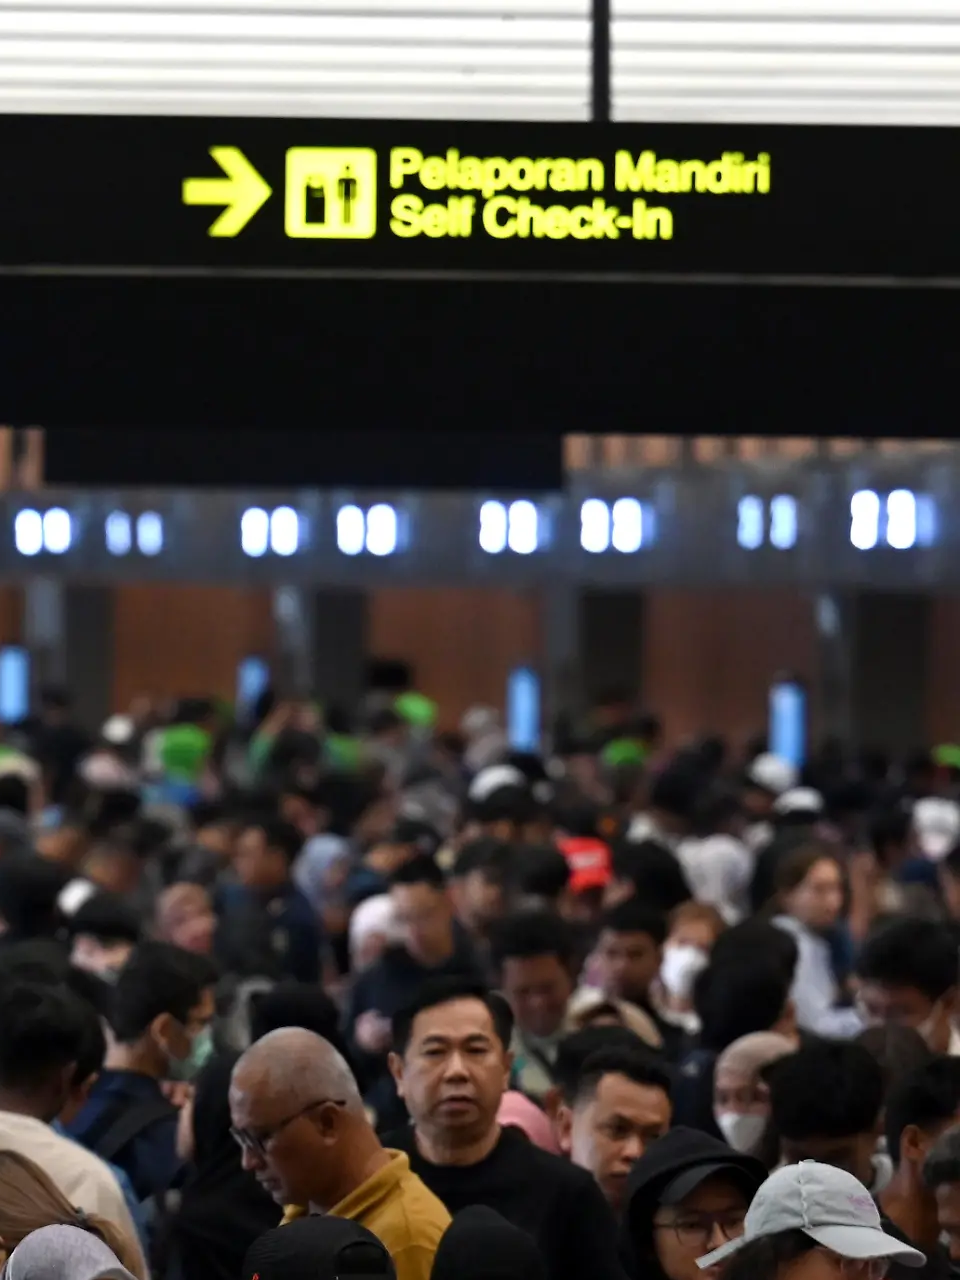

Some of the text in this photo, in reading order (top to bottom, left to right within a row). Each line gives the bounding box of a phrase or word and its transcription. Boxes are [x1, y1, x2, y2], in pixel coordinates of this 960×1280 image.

[390, 147, 770, 198] Pelaporan Mandiri
[390, 193, 673, 240] Self Check-In
